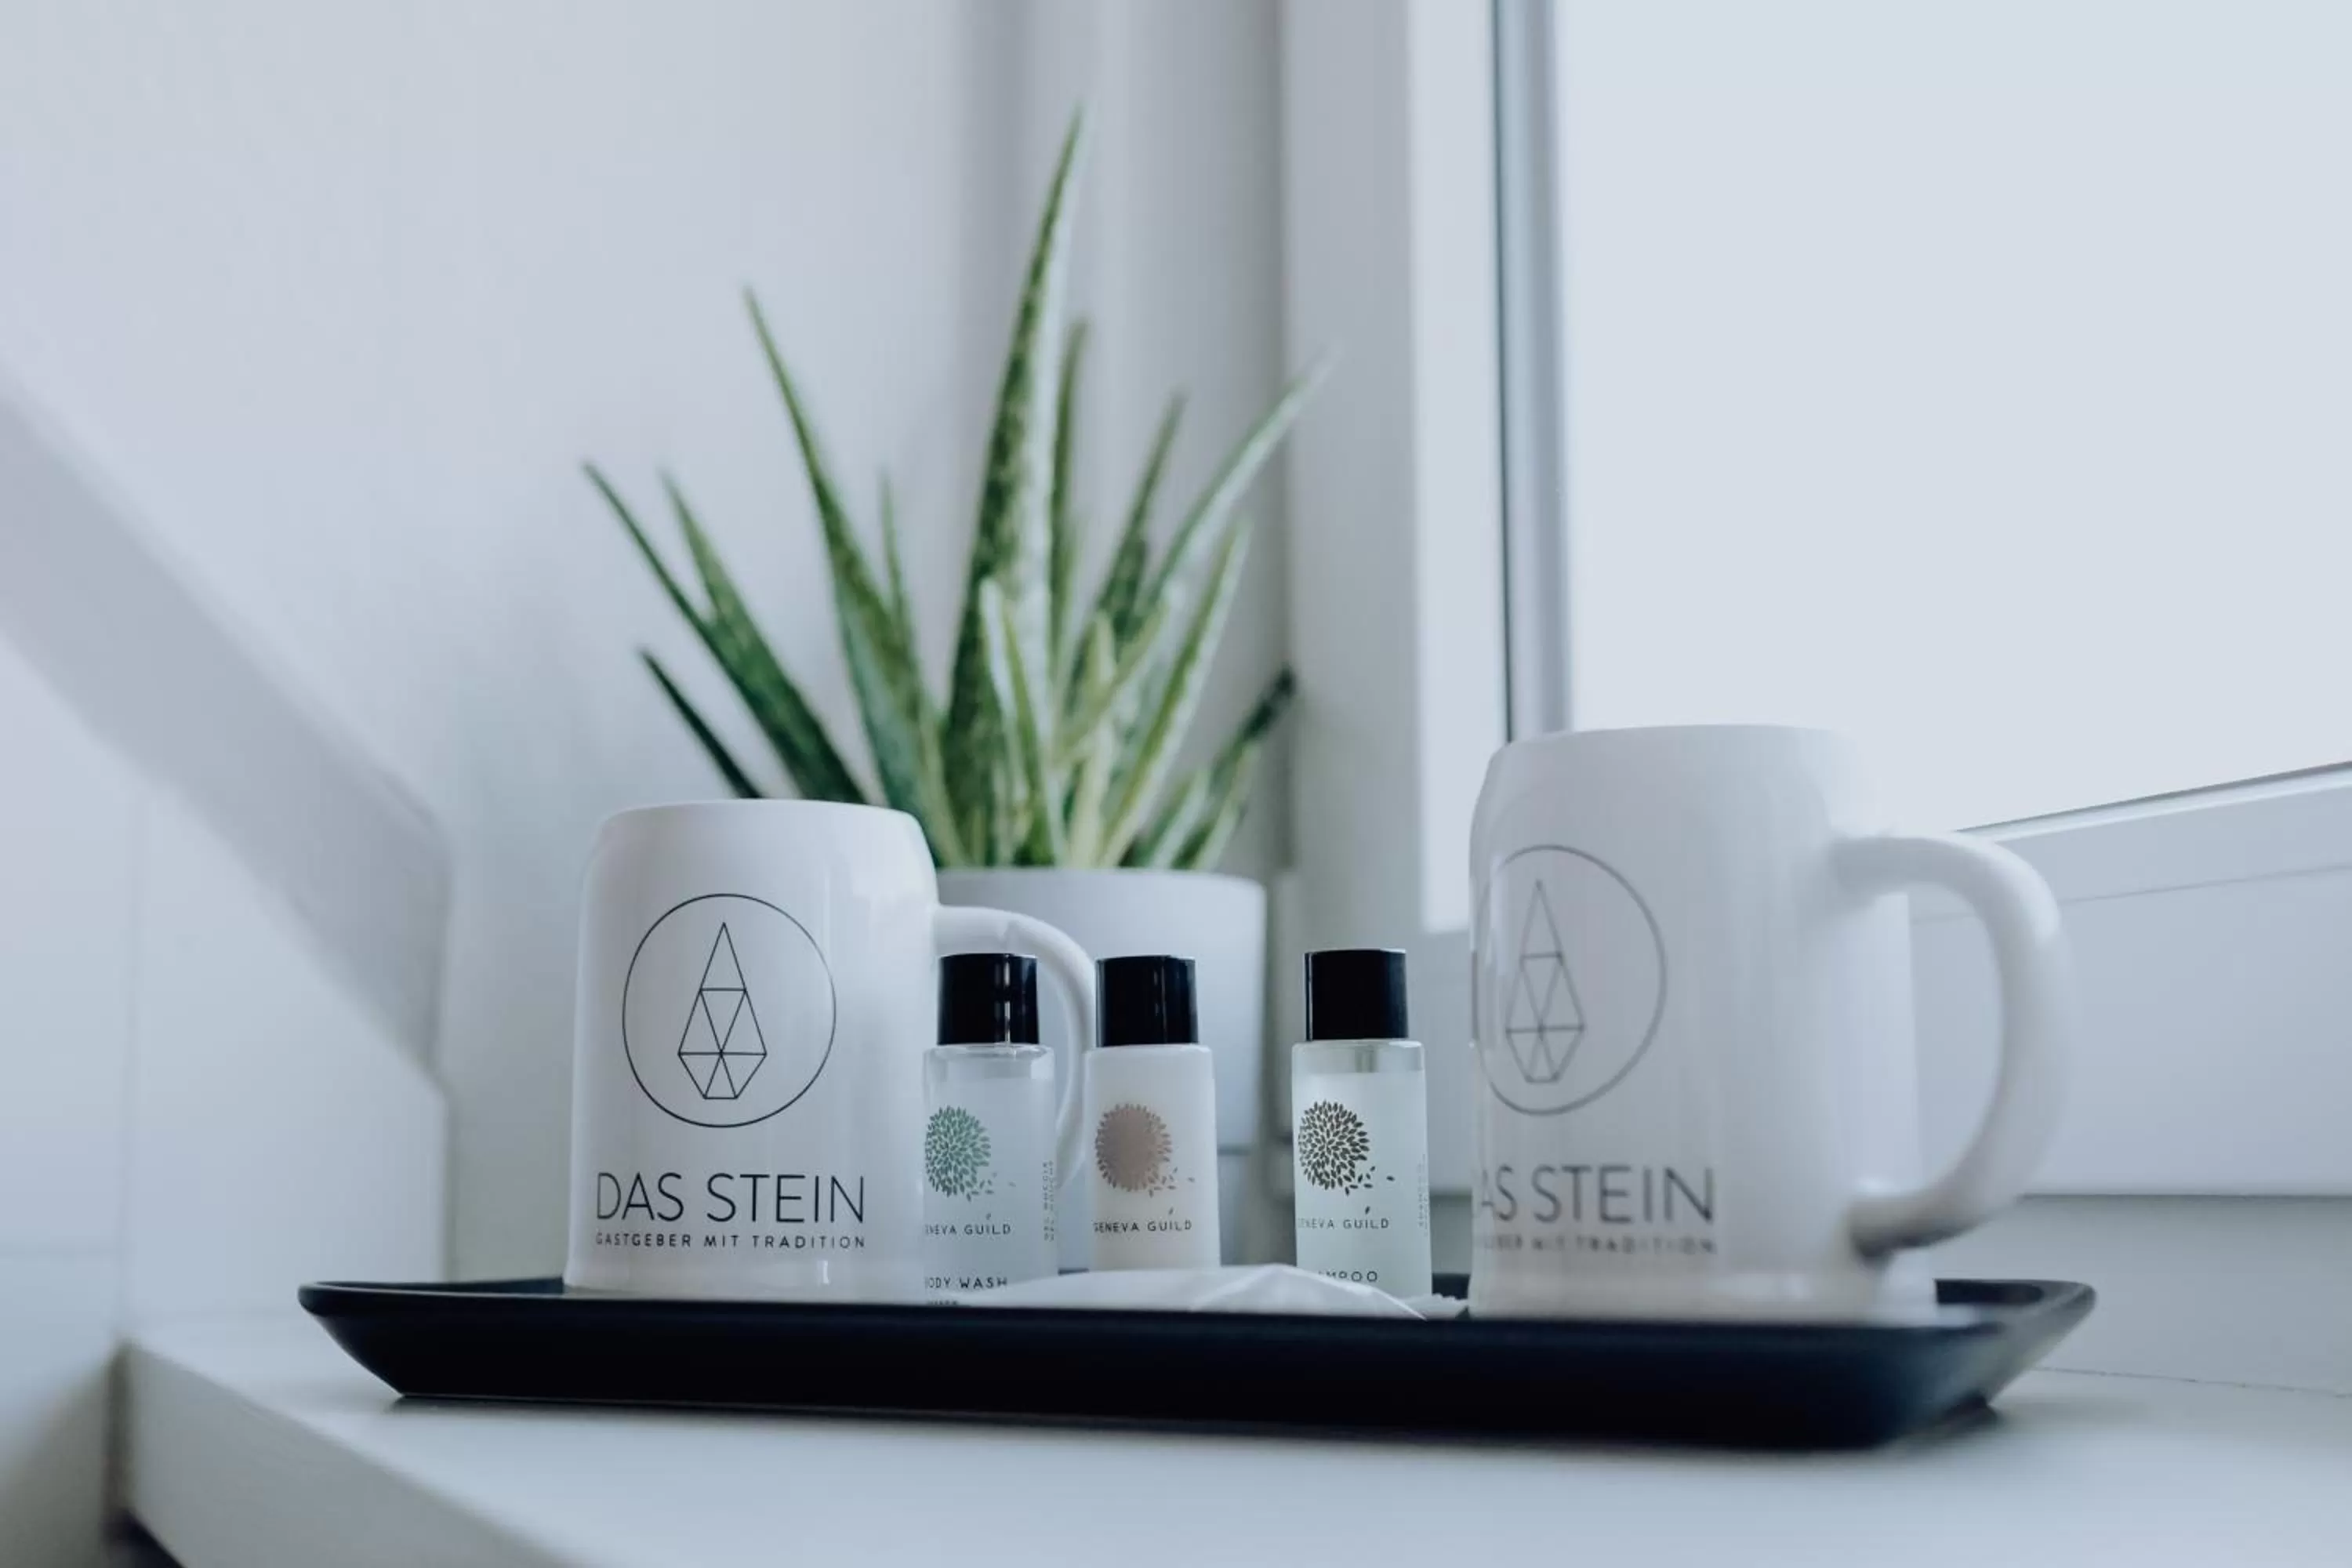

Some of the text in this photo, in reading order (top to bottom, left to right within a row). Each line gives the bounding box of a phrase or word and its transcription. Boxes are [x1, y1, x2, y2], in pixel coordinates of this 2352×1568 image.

[597, 1171, 865, 1224] DAS STEIN
[1478, 1163, 1518, 1222] AS
[1531, 1164, 1715, 1224] STEIN
[924, 1222, 1011, 1236] NEVA GUILD
[1147, 1219, 1193, 1232] GUILD
[1343, 1218, 1390, 1229] GUILD
[595, 1232, 866, 1249] GASTGEBER MIT TRADITION
[958, 1276, 1009, 1290] WASH
